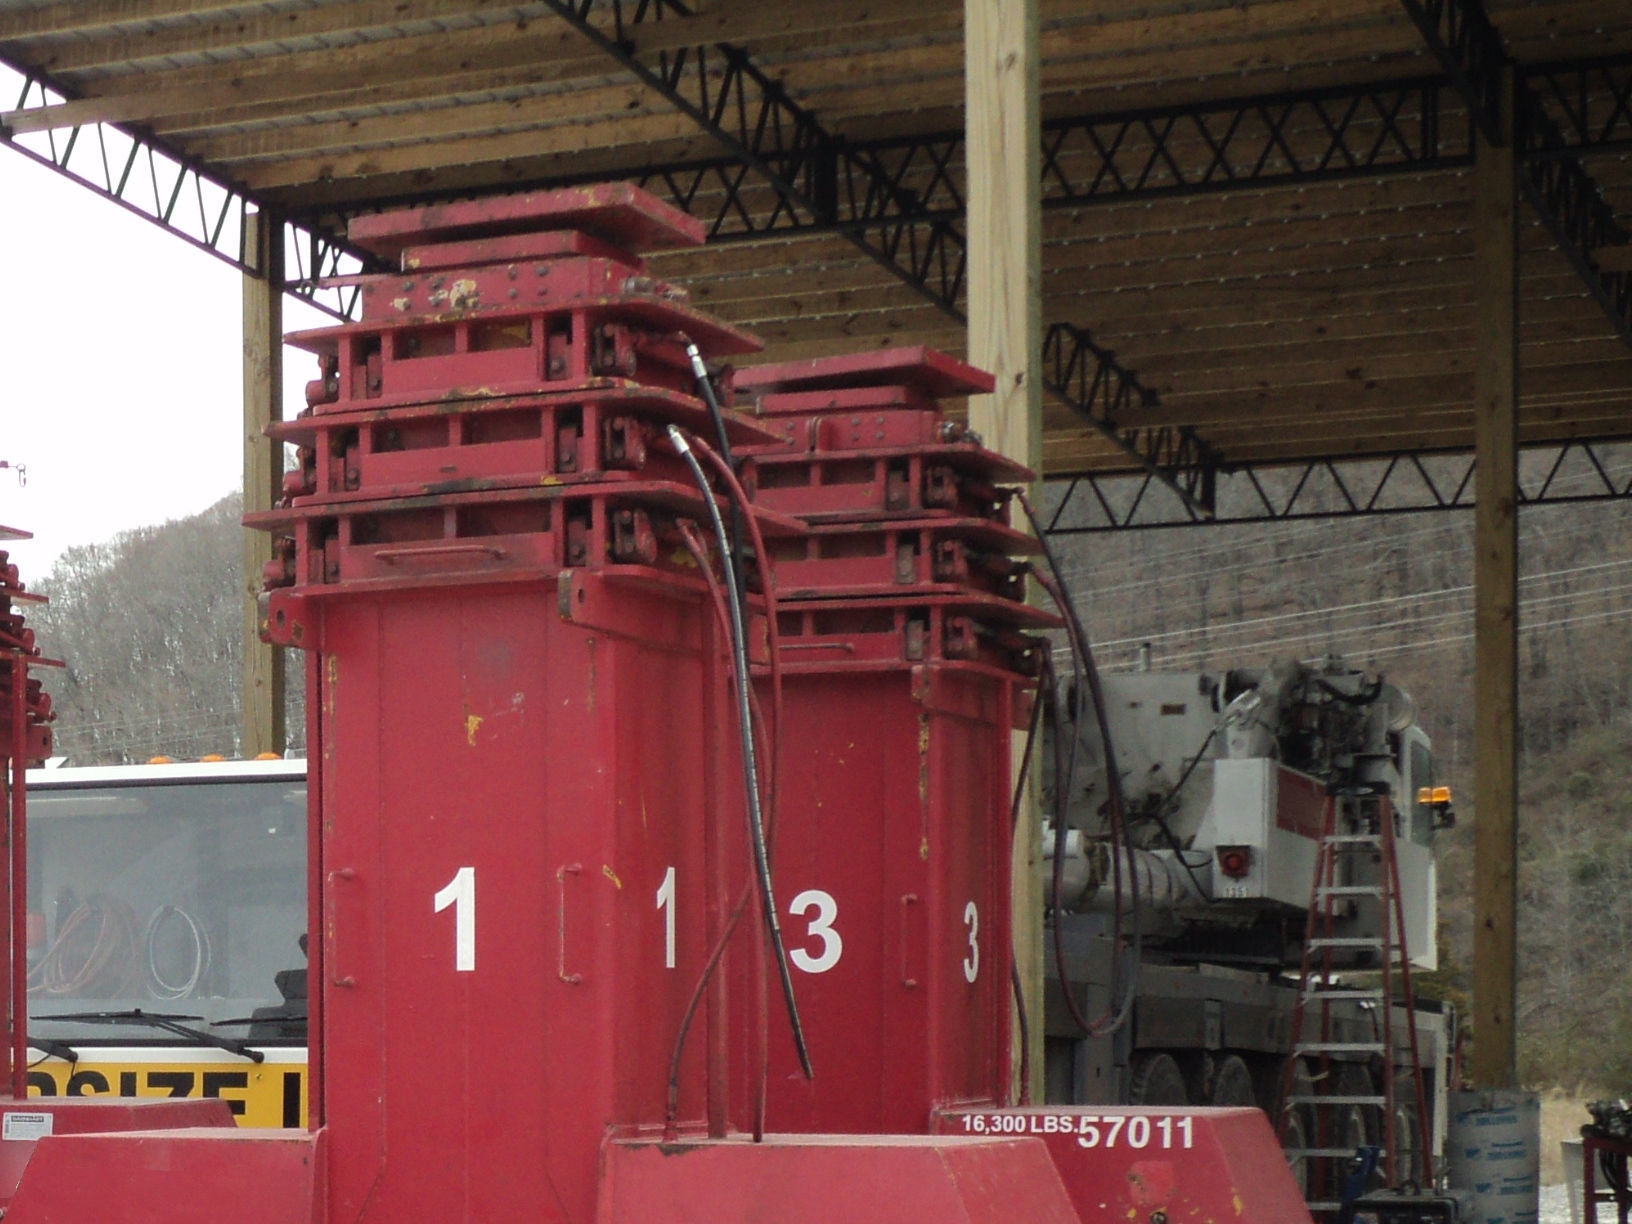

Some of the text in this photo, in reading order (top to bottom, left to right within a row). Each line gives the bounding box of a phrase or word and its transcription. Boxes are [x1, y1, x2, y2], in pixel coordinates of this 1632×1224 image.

[434, 867, 475, 971] 1
[656, 866, 675, 968] 1
[789, 889, 843, 973] 3
[964, 901, 979, 983] 3
[962, 1115, 1192, 1149] 16,300 LBS. 57011
